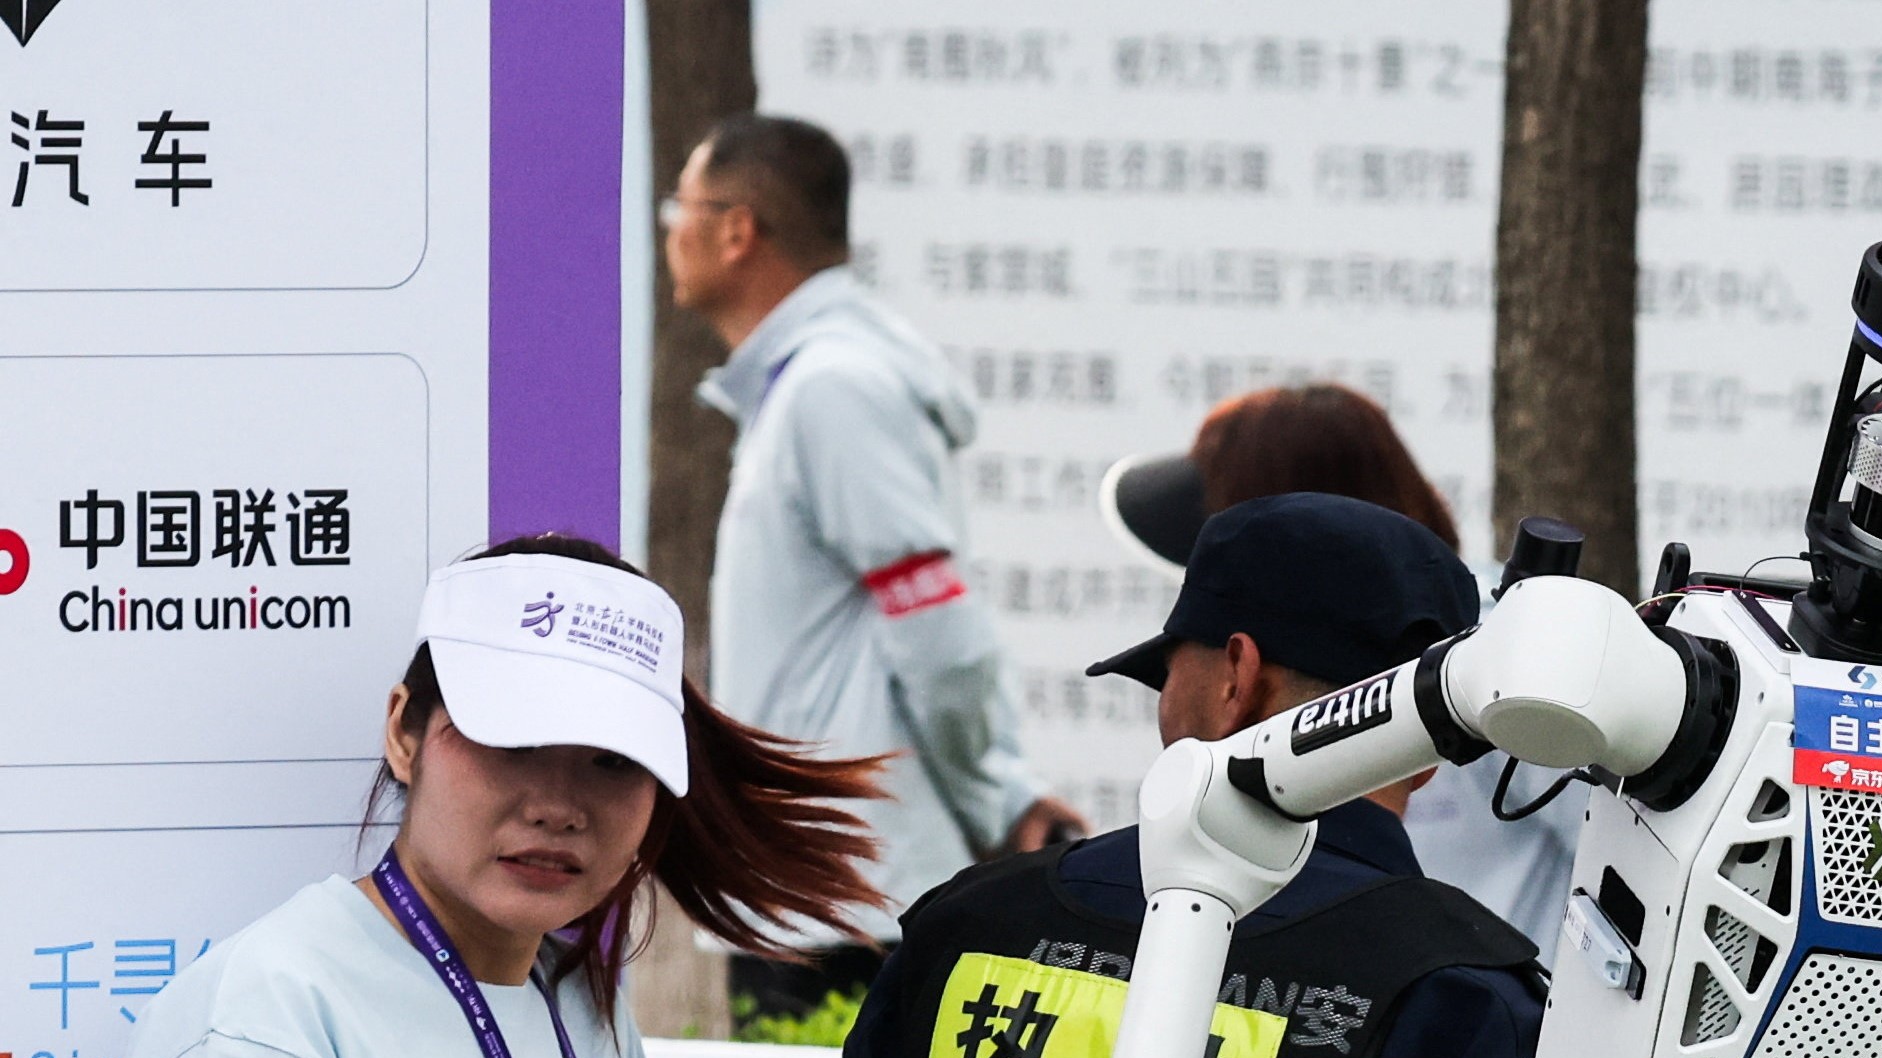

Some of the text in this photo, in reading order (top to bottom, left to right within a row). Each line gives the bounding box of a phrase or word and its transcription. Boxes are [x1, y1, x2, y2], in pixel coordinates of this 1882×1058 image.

[11, 110, 212, 207] 汽车
[59, 488, 351, 569] 中国联通
[59, 586, 351, 632] China unicom
[1298, 678, 1388, 734] Ultra
[29, 938, 212, 1030] 千寻
